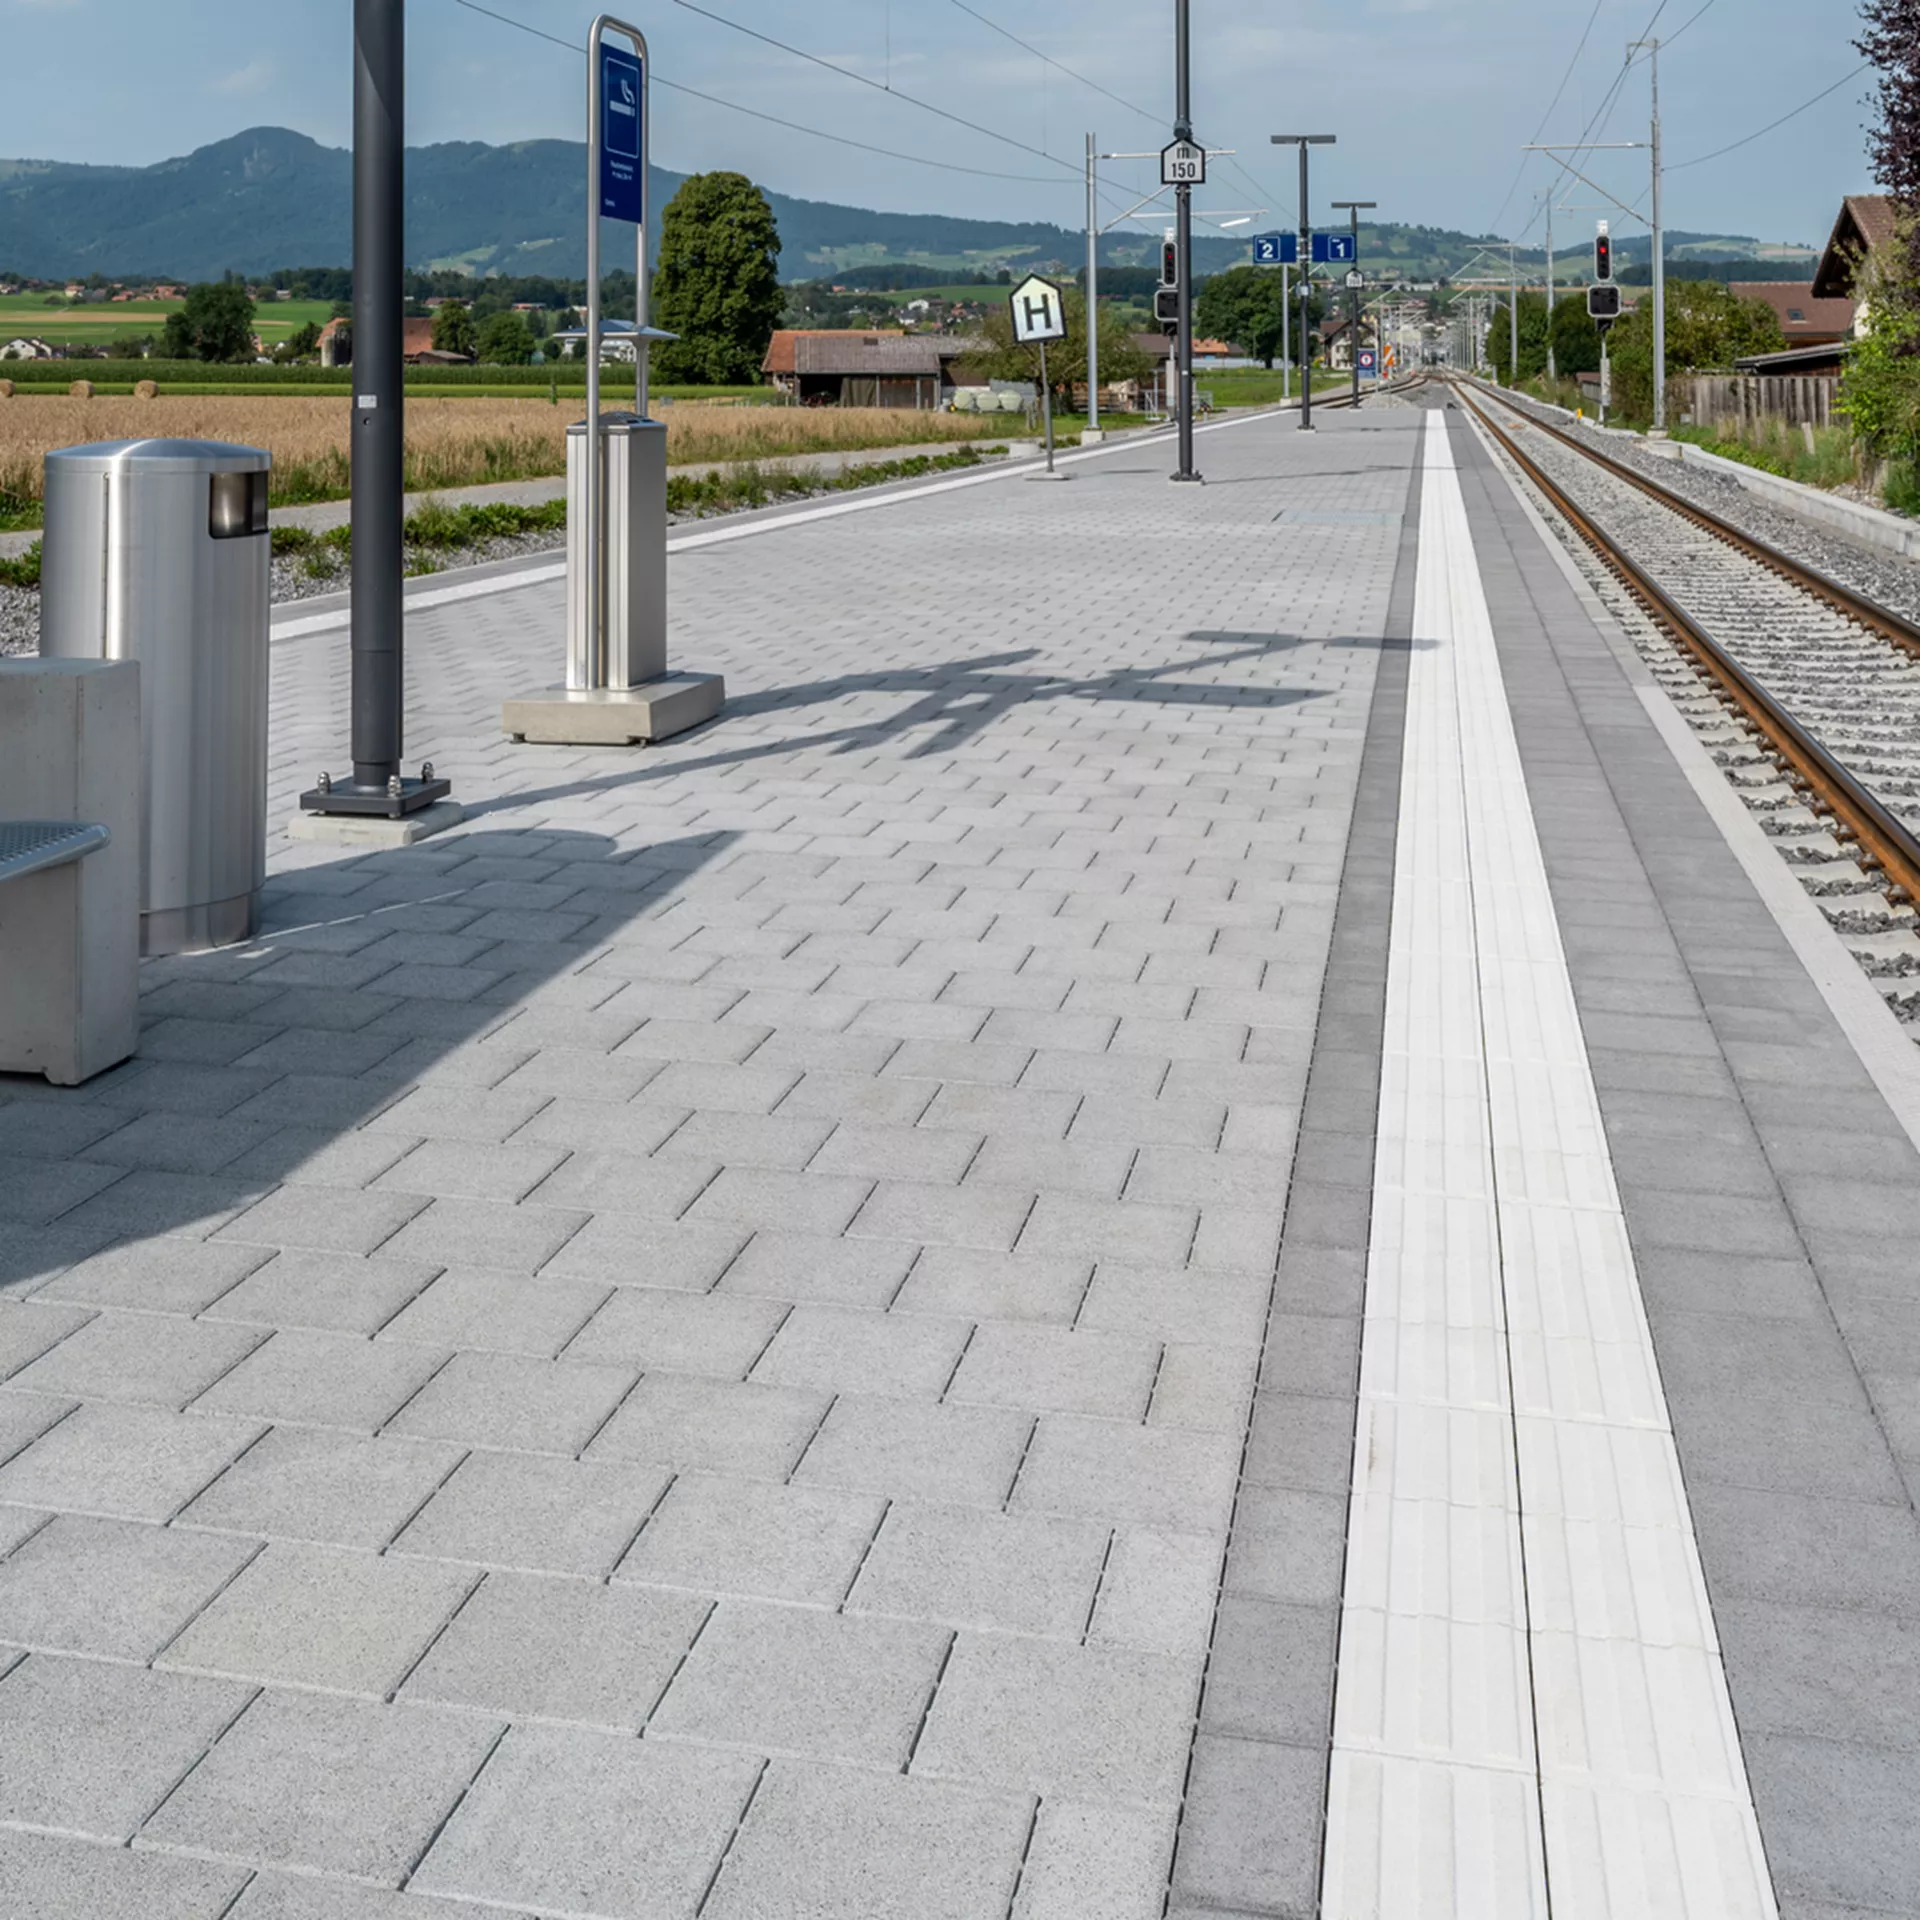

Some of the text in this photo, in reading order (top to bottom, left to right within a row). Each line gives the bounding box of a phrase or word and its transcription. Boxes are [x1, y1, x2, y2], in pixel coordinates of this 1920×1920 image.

[1171, 162, 1196, 178] 150
[1262, 243, 1274, 258] 2
[1336, 242, 1345, 258] 1
[1023, 293, 1052, 331] H
